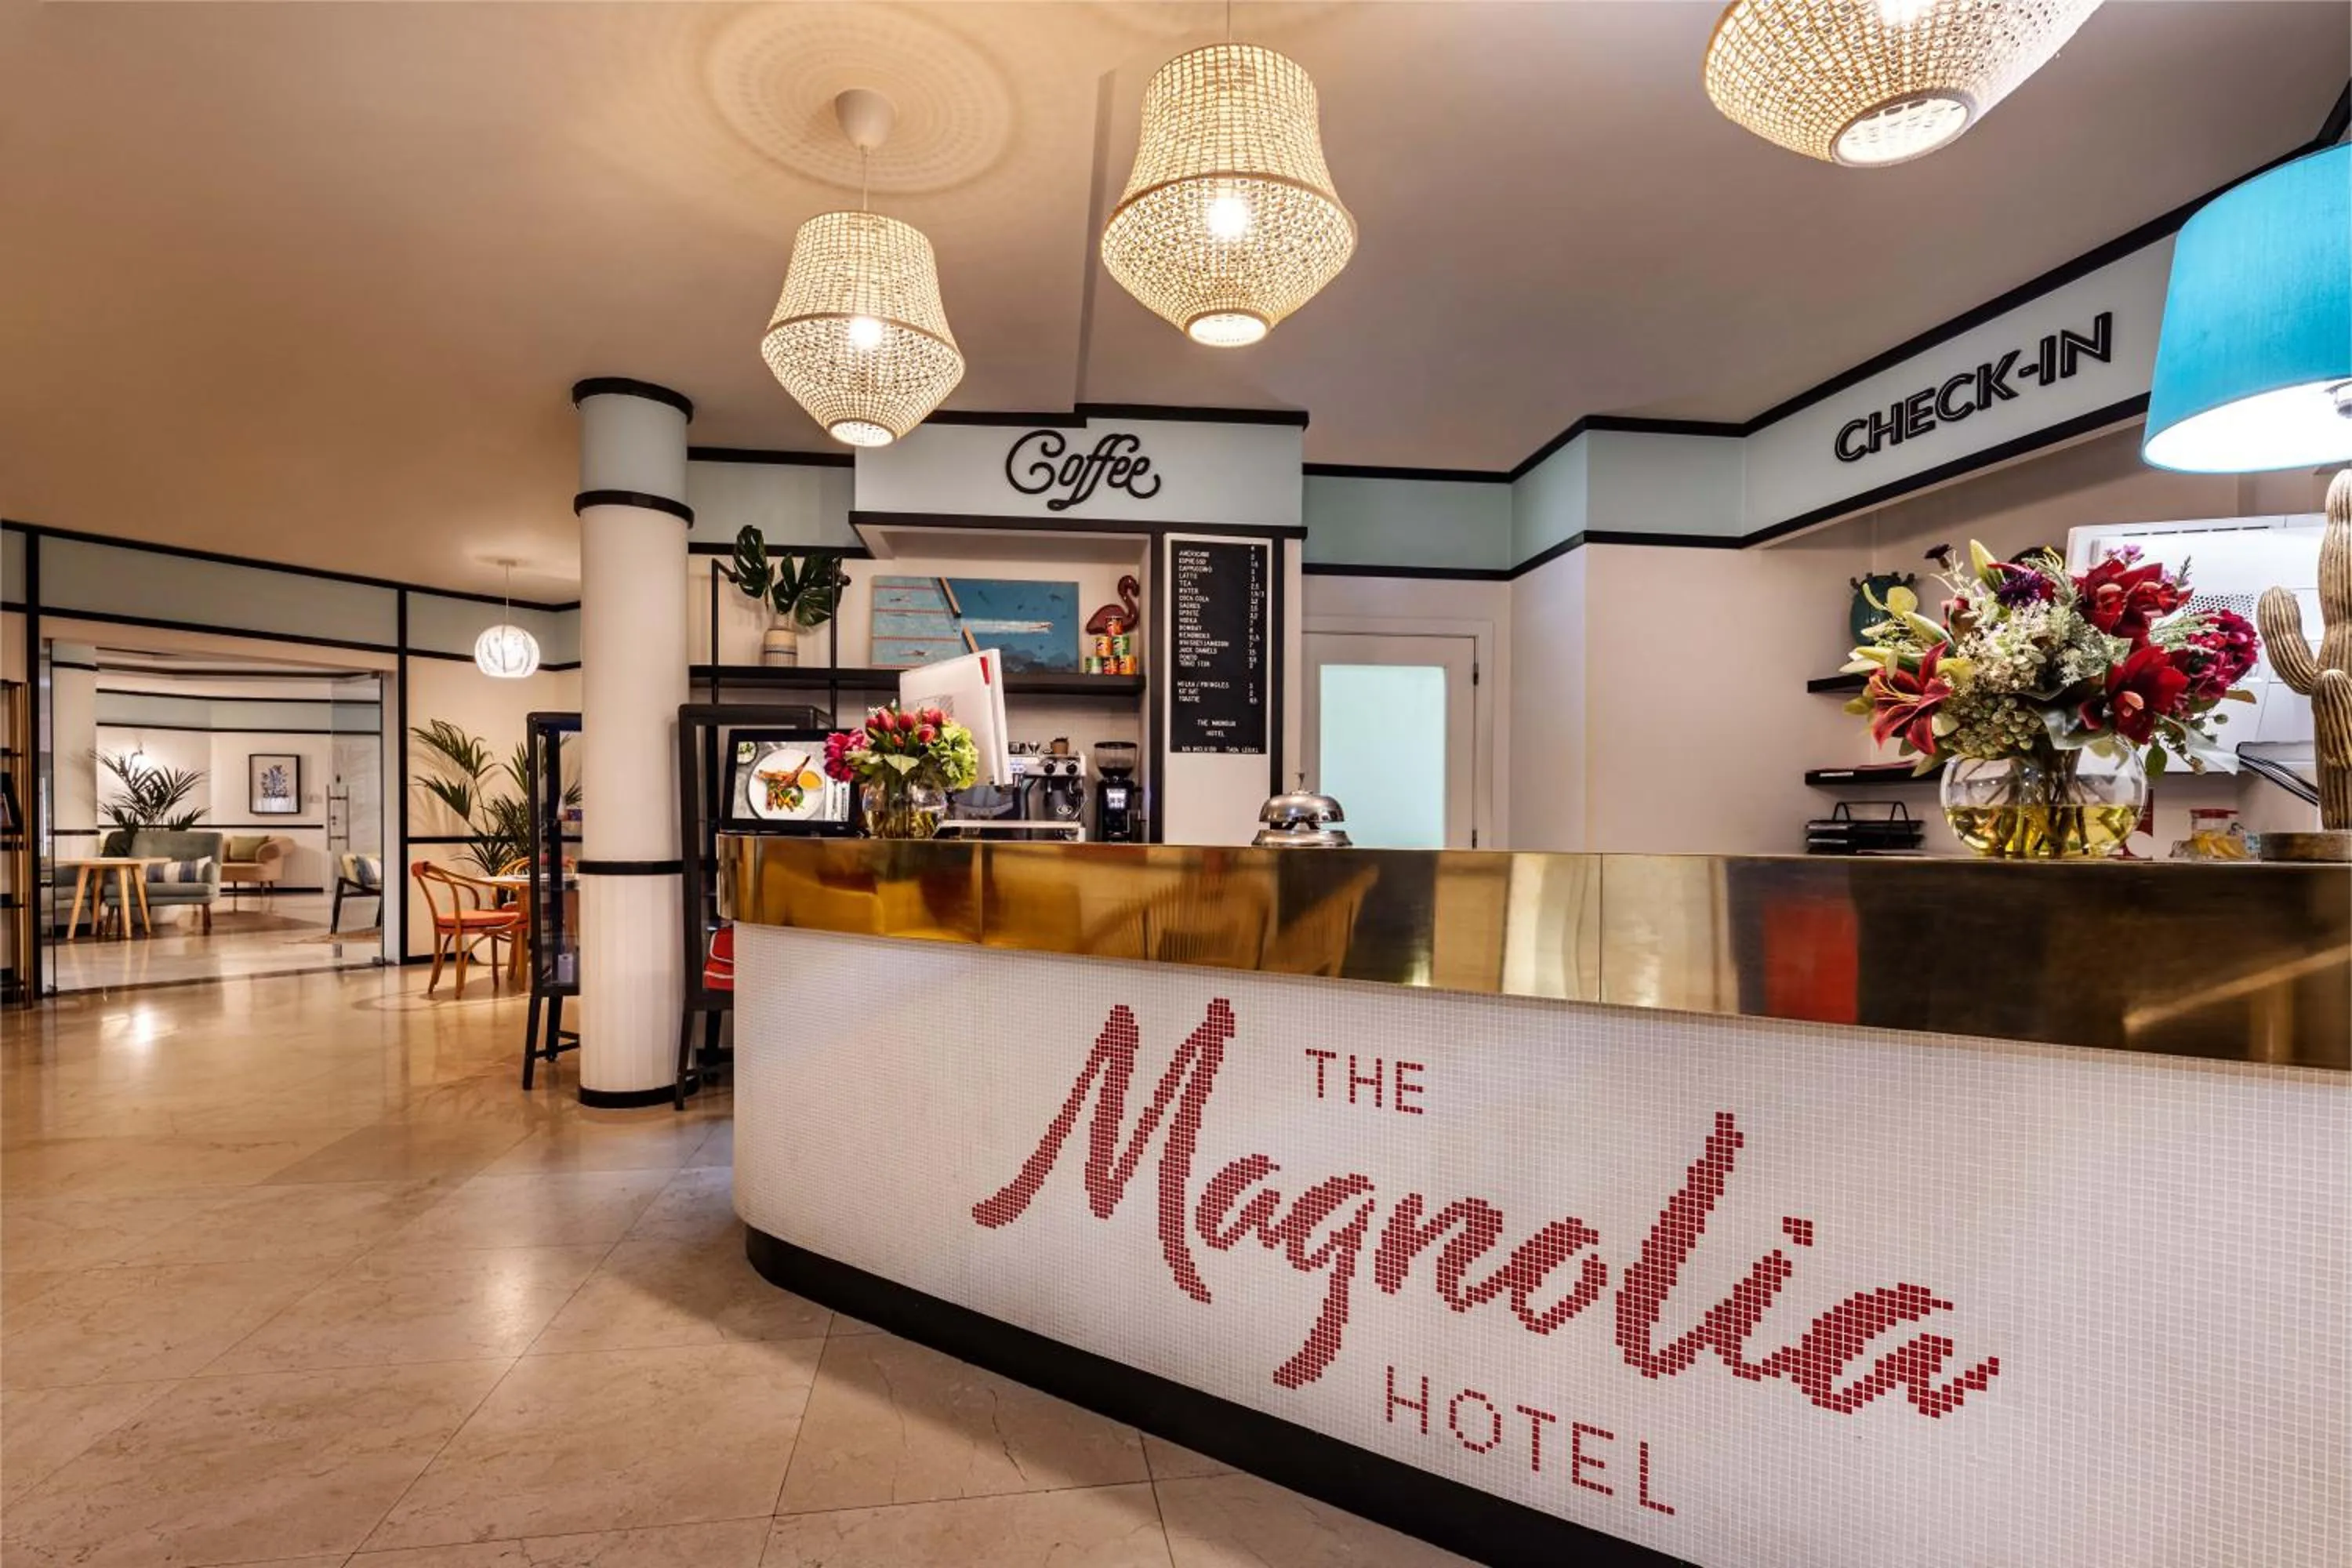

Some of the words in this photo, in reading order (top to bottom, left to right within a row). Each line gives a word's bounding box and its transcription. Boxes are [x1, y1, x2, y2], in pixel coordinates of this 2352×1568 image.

[1835, 311, 2113, 462] CHECK-IN
[1006, 429, 1160, 511] Coffee
[1306, 1048, 1425, 1114] THE
[973, 997, 2000, 1417] Magnolia
[1386, 1365, 1675, 1515] HOTEL
